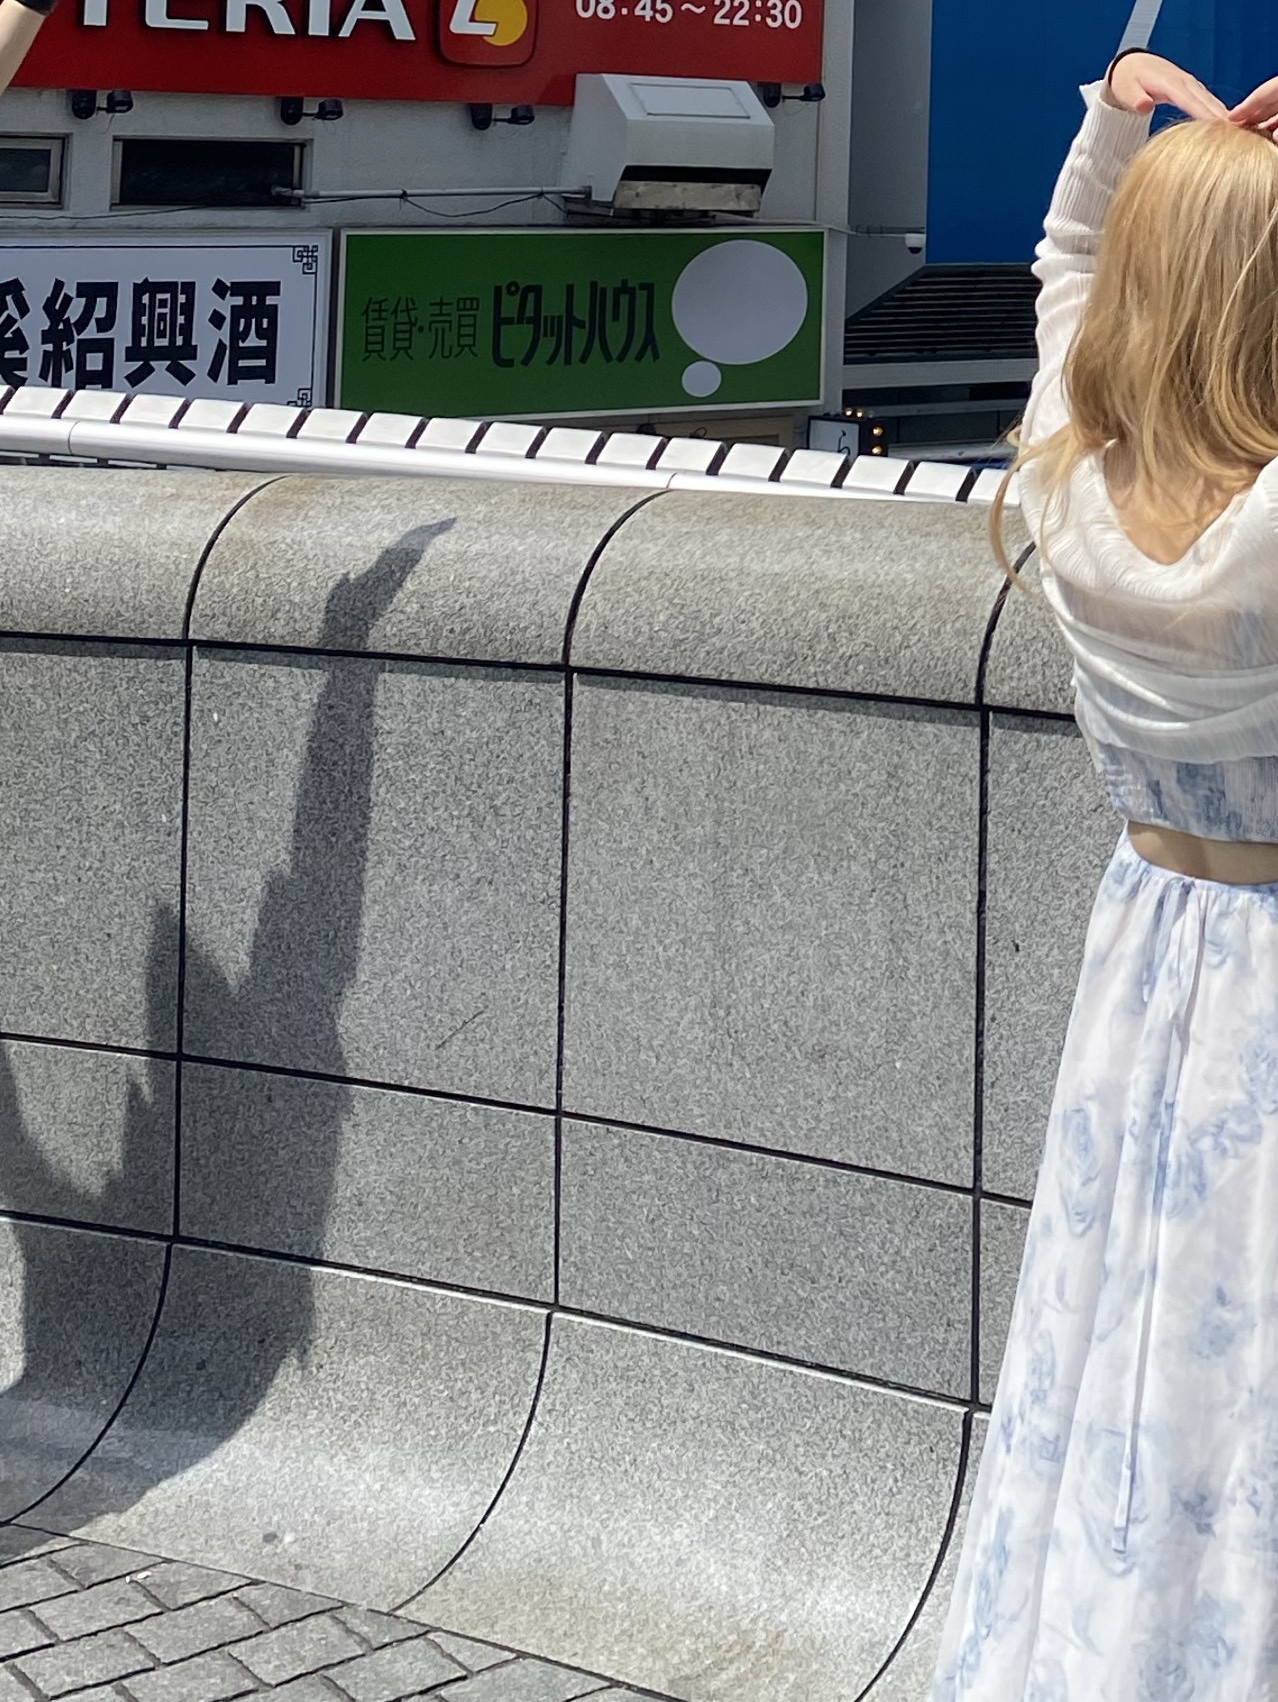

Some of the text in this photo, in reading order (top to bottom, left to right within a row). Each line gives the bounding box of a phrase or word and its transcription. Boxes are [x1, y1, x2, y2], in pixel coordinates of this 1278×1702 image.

[491, 278, 661, 368] ピタットハウス
